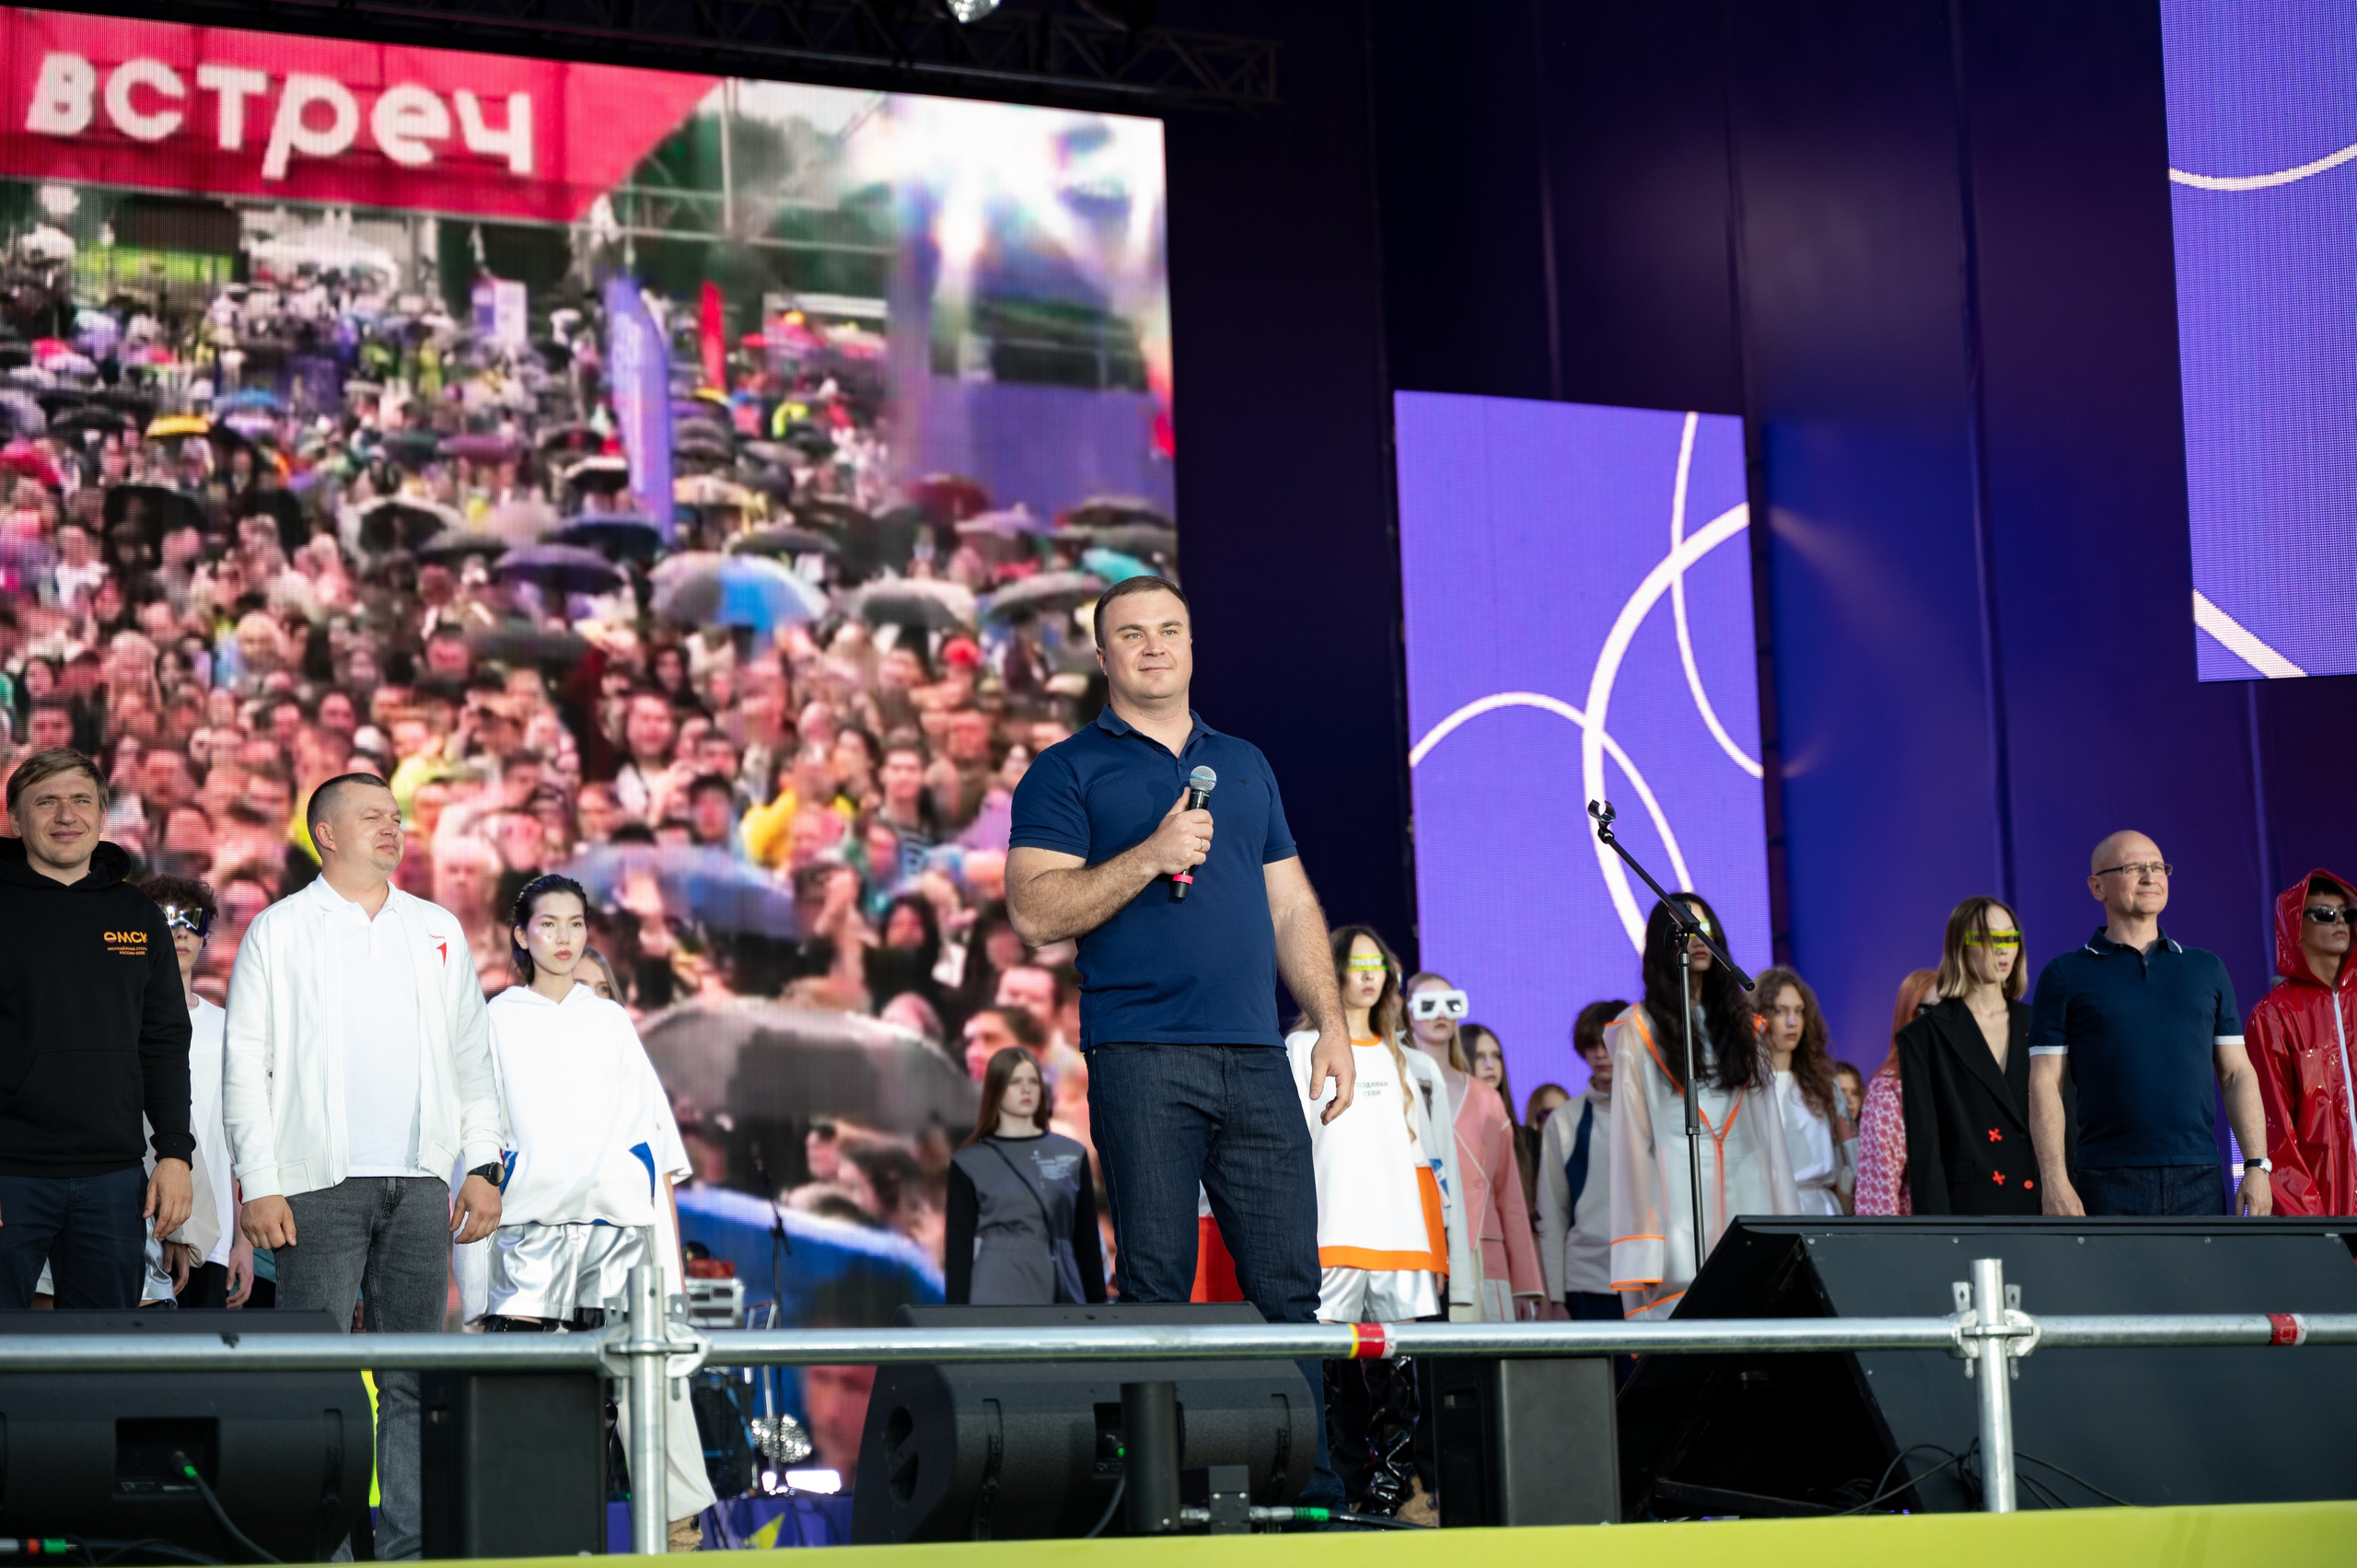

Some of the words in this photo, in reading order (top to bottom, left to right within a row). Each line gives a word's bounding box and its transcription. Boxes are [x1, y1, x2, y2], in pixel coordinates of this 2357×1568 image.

[25, 52, 534, 180] встреч
[103, 931, 147, 944] ОМСК
[1355, 1081, 1388, 1089] ОЗДАВАЯ
[1363, 1089, 1381, 1098] СЕБЯ
